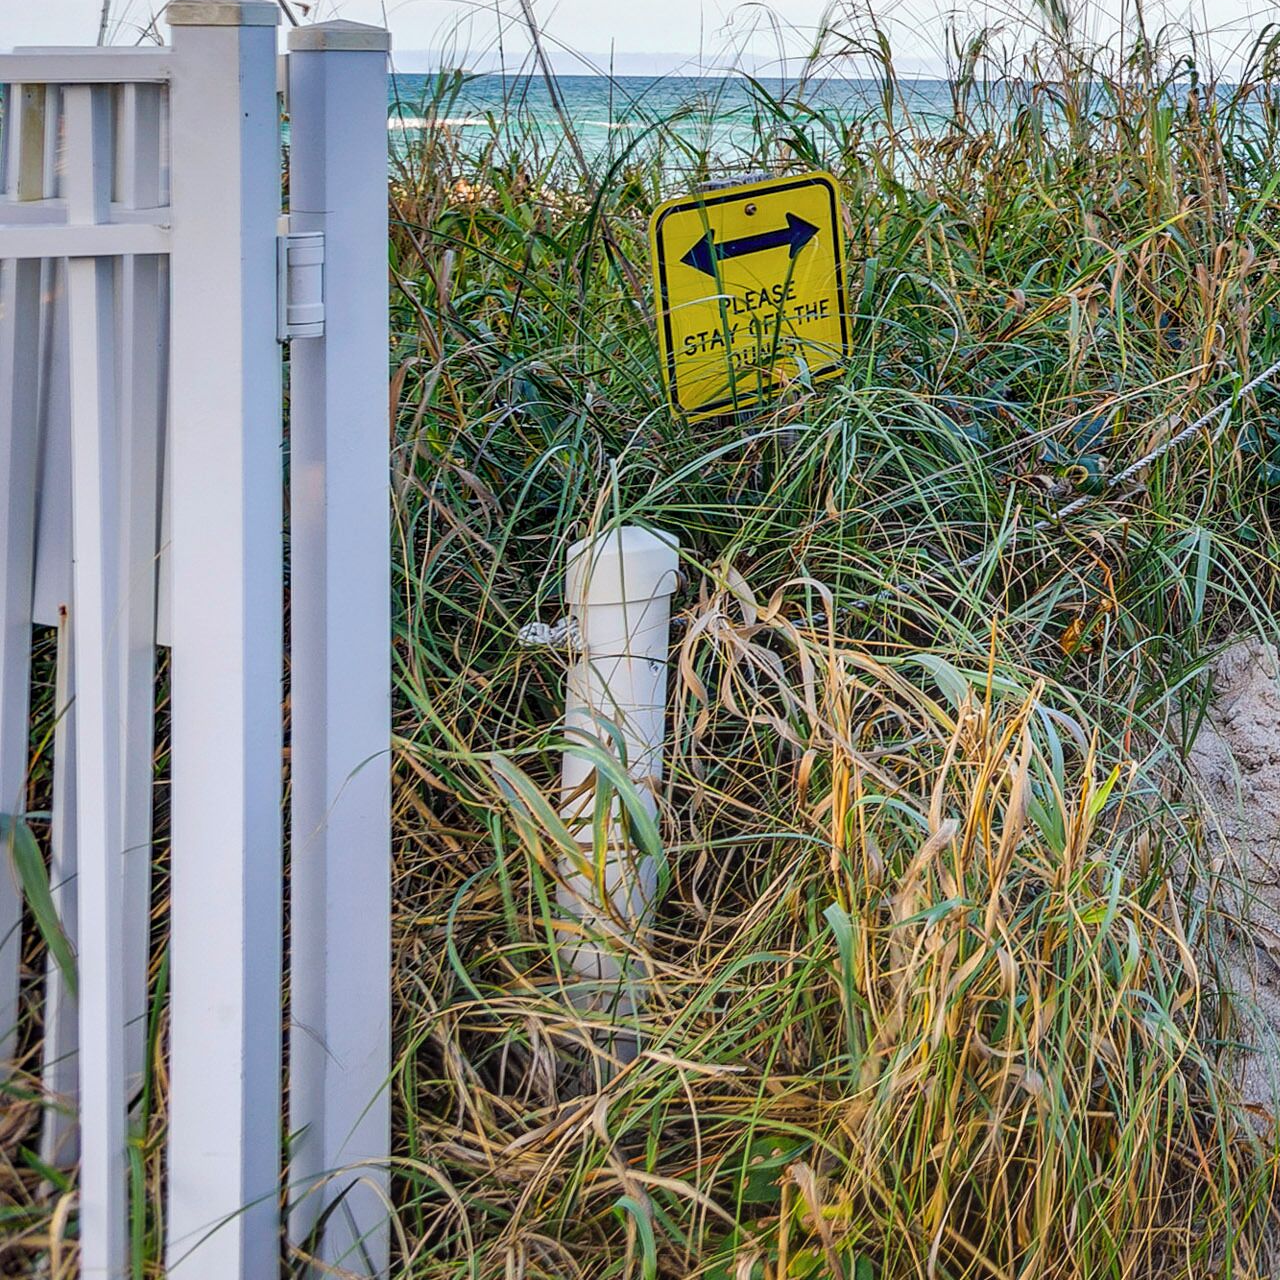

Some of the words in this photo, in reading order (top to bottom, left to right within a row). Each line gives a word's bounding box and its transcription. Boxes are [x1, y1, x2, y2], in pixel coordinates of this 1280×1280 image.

[719, 280, 797, 318] PLEASE
[684, 322, 739, 356] STAY
[794, 298, 830, 325] THE
